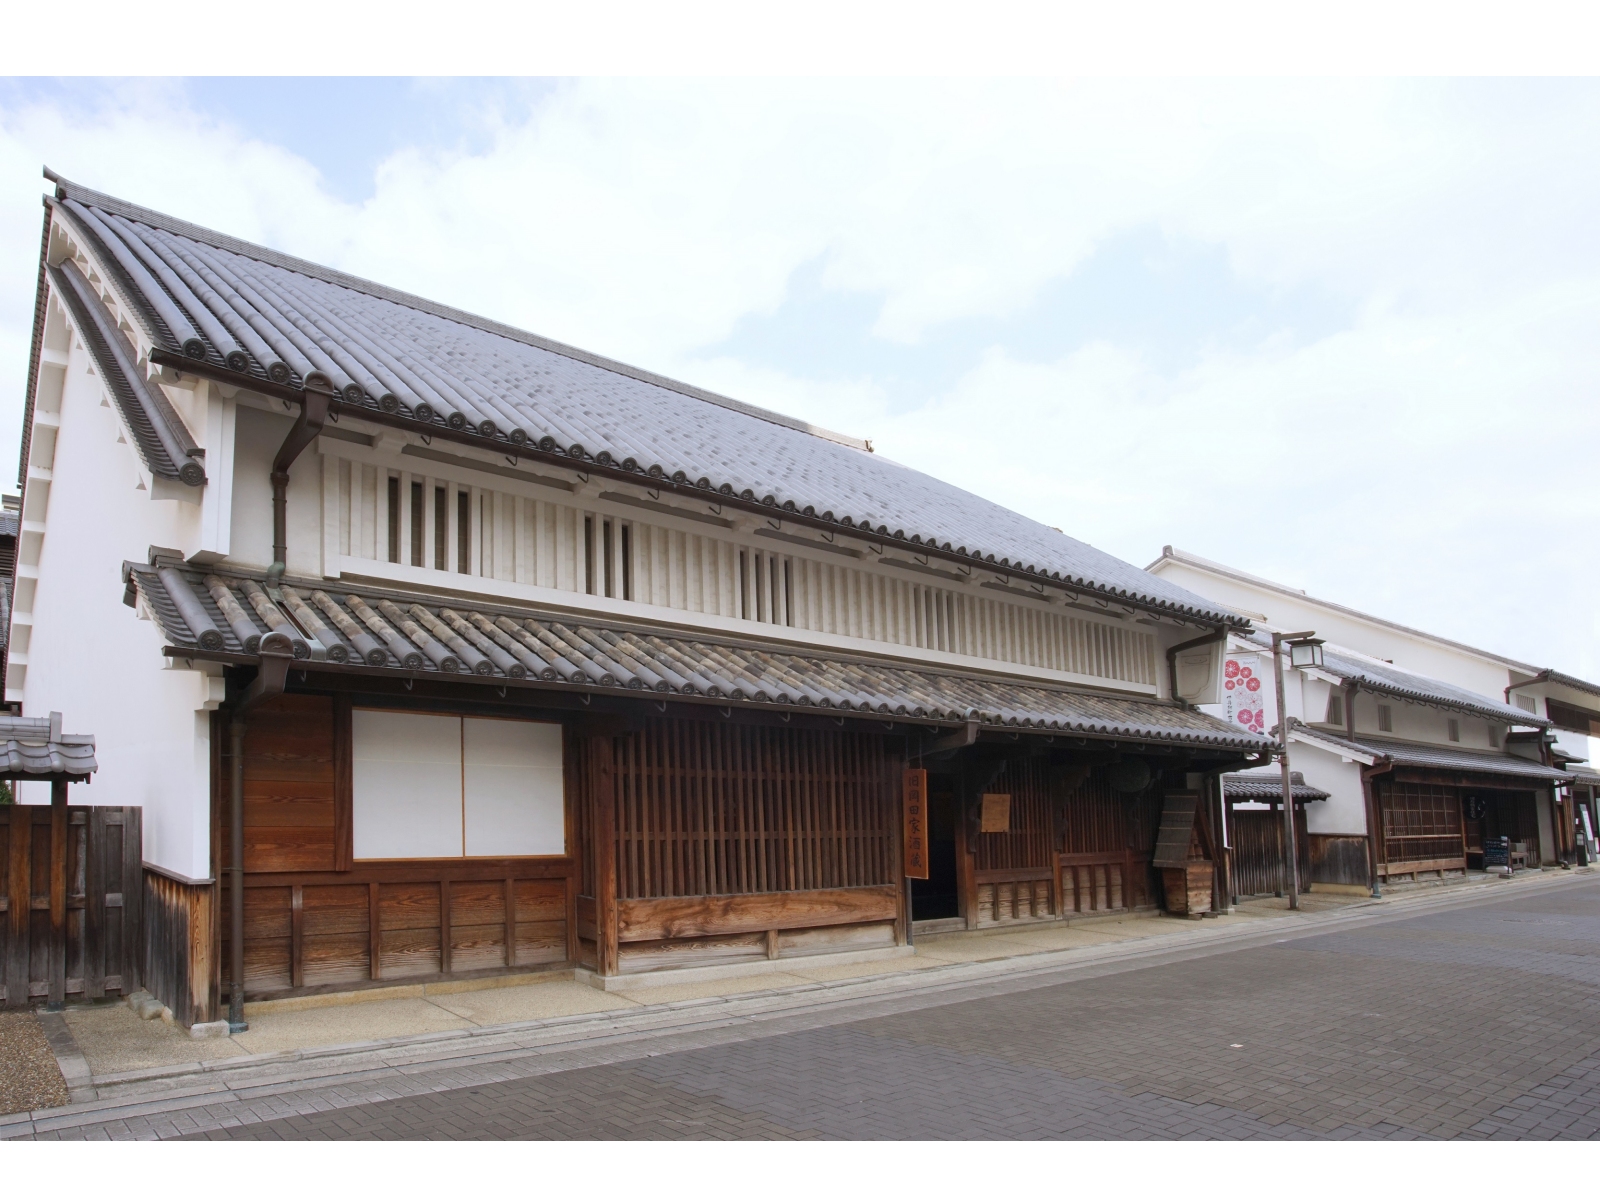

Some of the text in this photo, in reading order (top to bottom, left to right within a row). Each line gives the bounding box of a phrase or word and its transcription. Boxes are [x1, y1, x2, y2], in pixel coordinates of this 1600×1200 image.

[908, 775, 922, 869] 旧岡田家酒蔵
